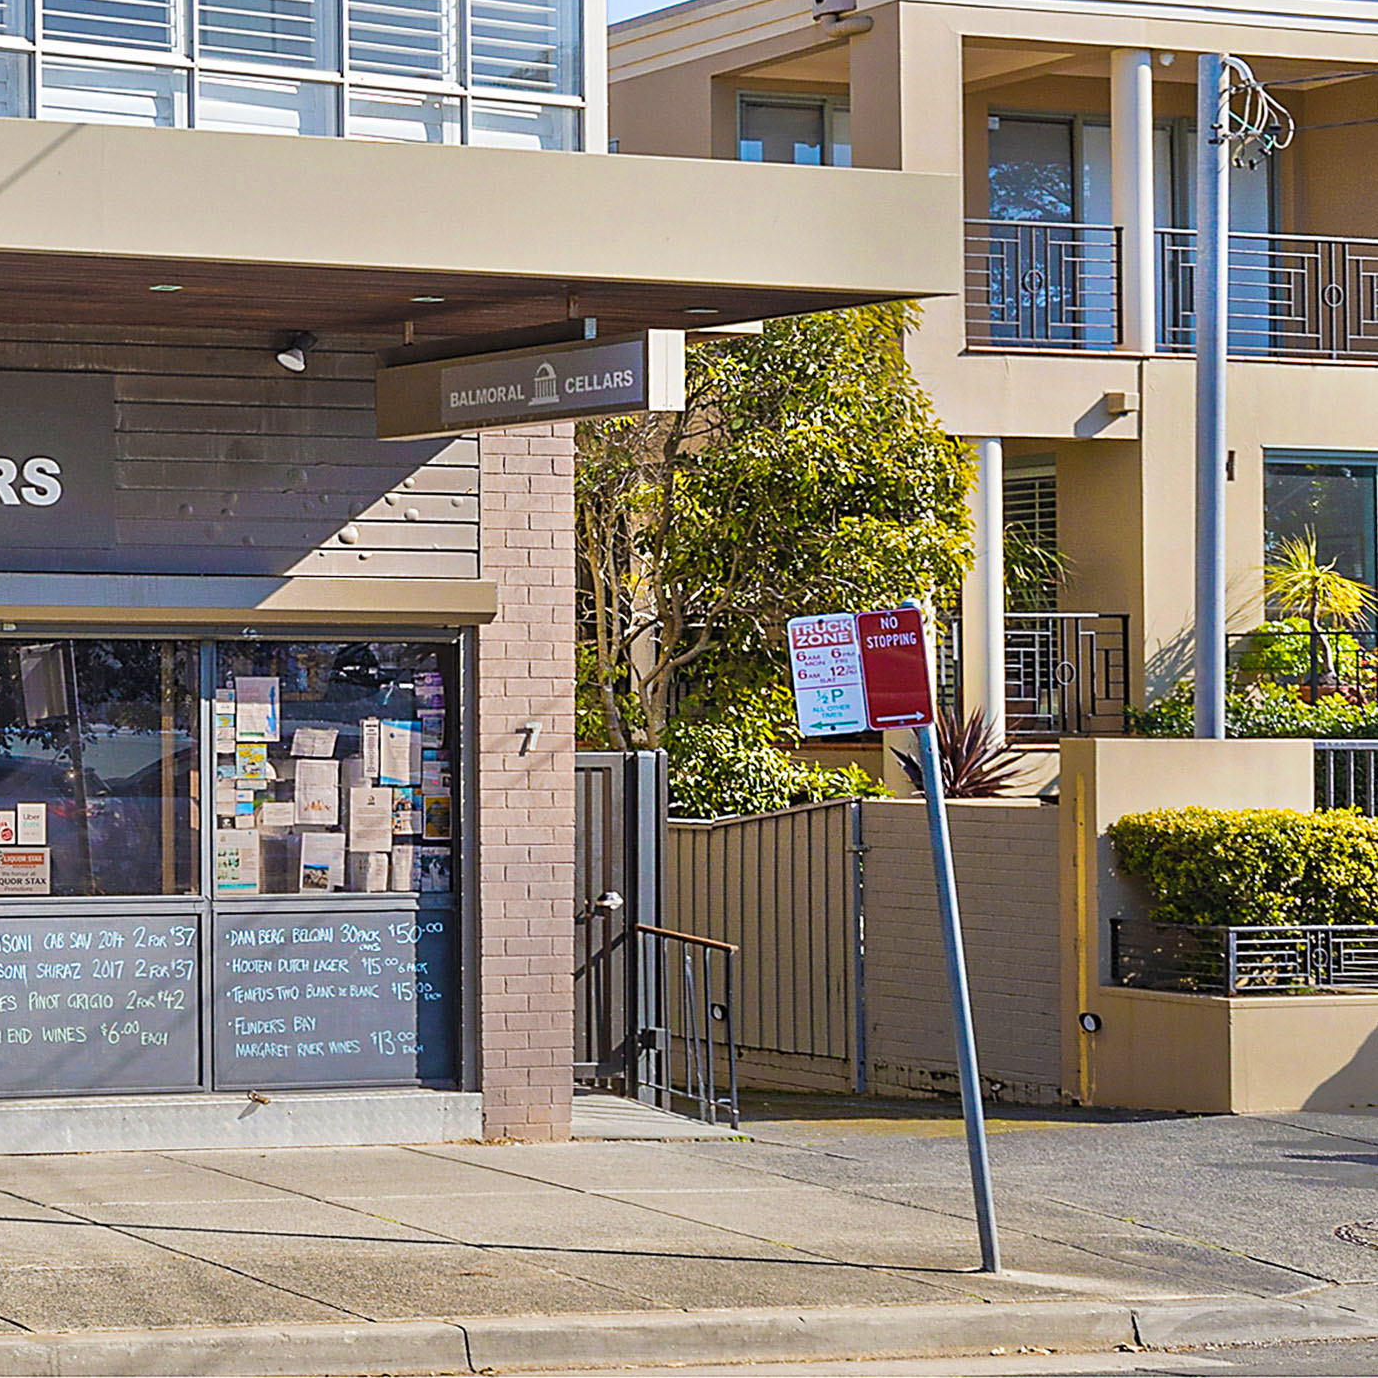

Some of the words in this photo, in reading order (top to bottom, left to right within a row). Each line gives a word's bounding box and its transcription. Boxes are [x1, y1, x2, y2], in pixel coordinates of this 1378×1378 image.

[450, 384, 525, 408] BALMORAL
[565, 370, 634, 394] CELLARS
[794, 620, 852, 635] TRUCK
[880, 616, 898, 630] NO
[796, 631, 850, 647] ZONE
[866, 632, 917, 649] STOPPING
[25, 877, 47, 885] STAX
[43, 932, 65, 950] CAB
[69, 932, 93, 950] SAV
[132, 926, 147, 948] 2
[148, 934, 168, 948] FOR
[36, 962, 82, 979] SHIRAZ
[92, 958, 125, 979] 2017
[135, 959, 148, 978] 2
[149, 964, 171, 979] FOR
[278, 958, 310, 973] DUTCH
[313, 958, 350, 973] LAGER
[28, 991, 62, 1011] PINOT
[67, 993, 114, 1010] GRIGIO
[126, 989, 138, 1010] 2
[137, 995, 156, 1008] FOR
[275, 985, 300, 1000] TWO
[293, 1015, 316, 1033] BAY
[7, 1027, 33, 1044] END
[42, 1026, 88, 1043] WINES
[140, 1031, 169, 1046] EACH
